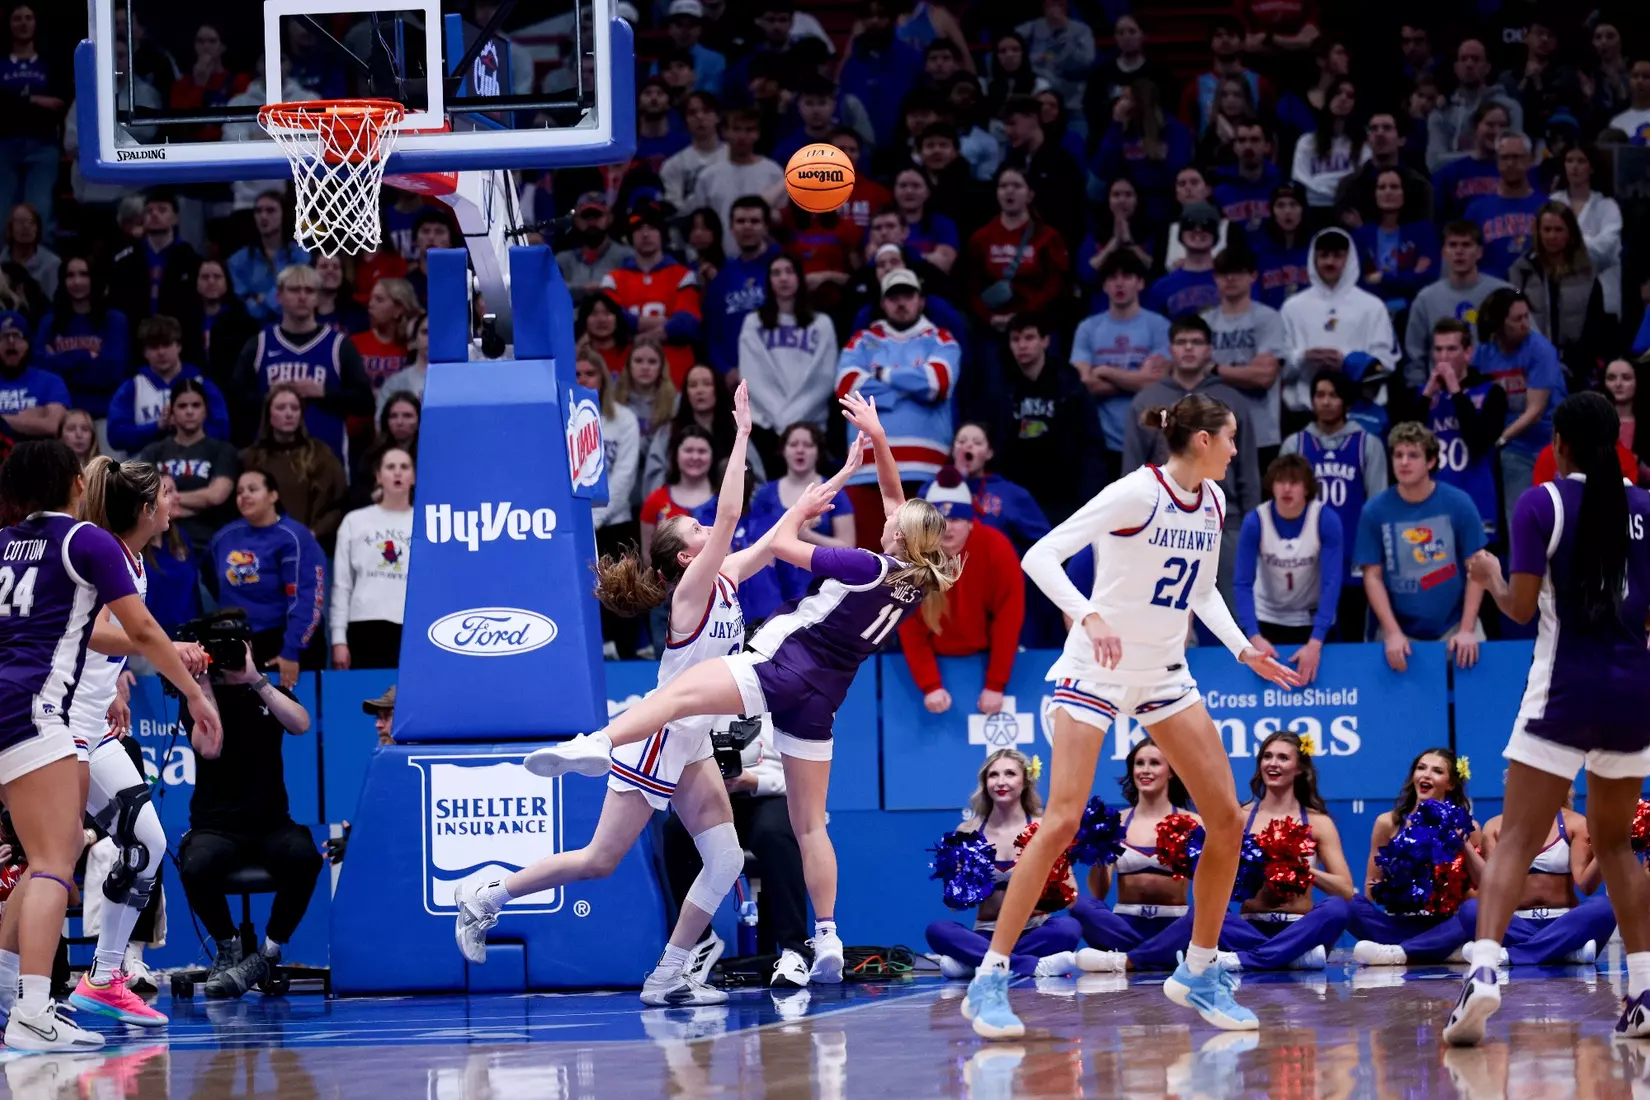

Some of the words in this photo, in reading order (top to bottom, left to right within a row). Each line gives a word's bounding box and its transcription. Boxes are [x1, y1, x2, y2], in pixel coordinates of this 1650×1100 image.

[117, 149, 166, 162] SPALDING
[798, 169, 844, 183] Wilson
[1314, 462, 1356, 481] ANSAS
[3, 538, 47, 562] COTTON
[0, 565, 39, 617] 24
[1150, 556, 1200, 611] 21
[1284, 571, 1294, 591] 1
[454, 615, 531, 646] Ford
[860, 602, 904, 645] 11
[1264, 687, 1358, 707] BlueShield
[436, 796, 548, 819] SHELTER
[436, 819, 547, 836] INSURANCE
[1531, 908, 1550, 919] KU
